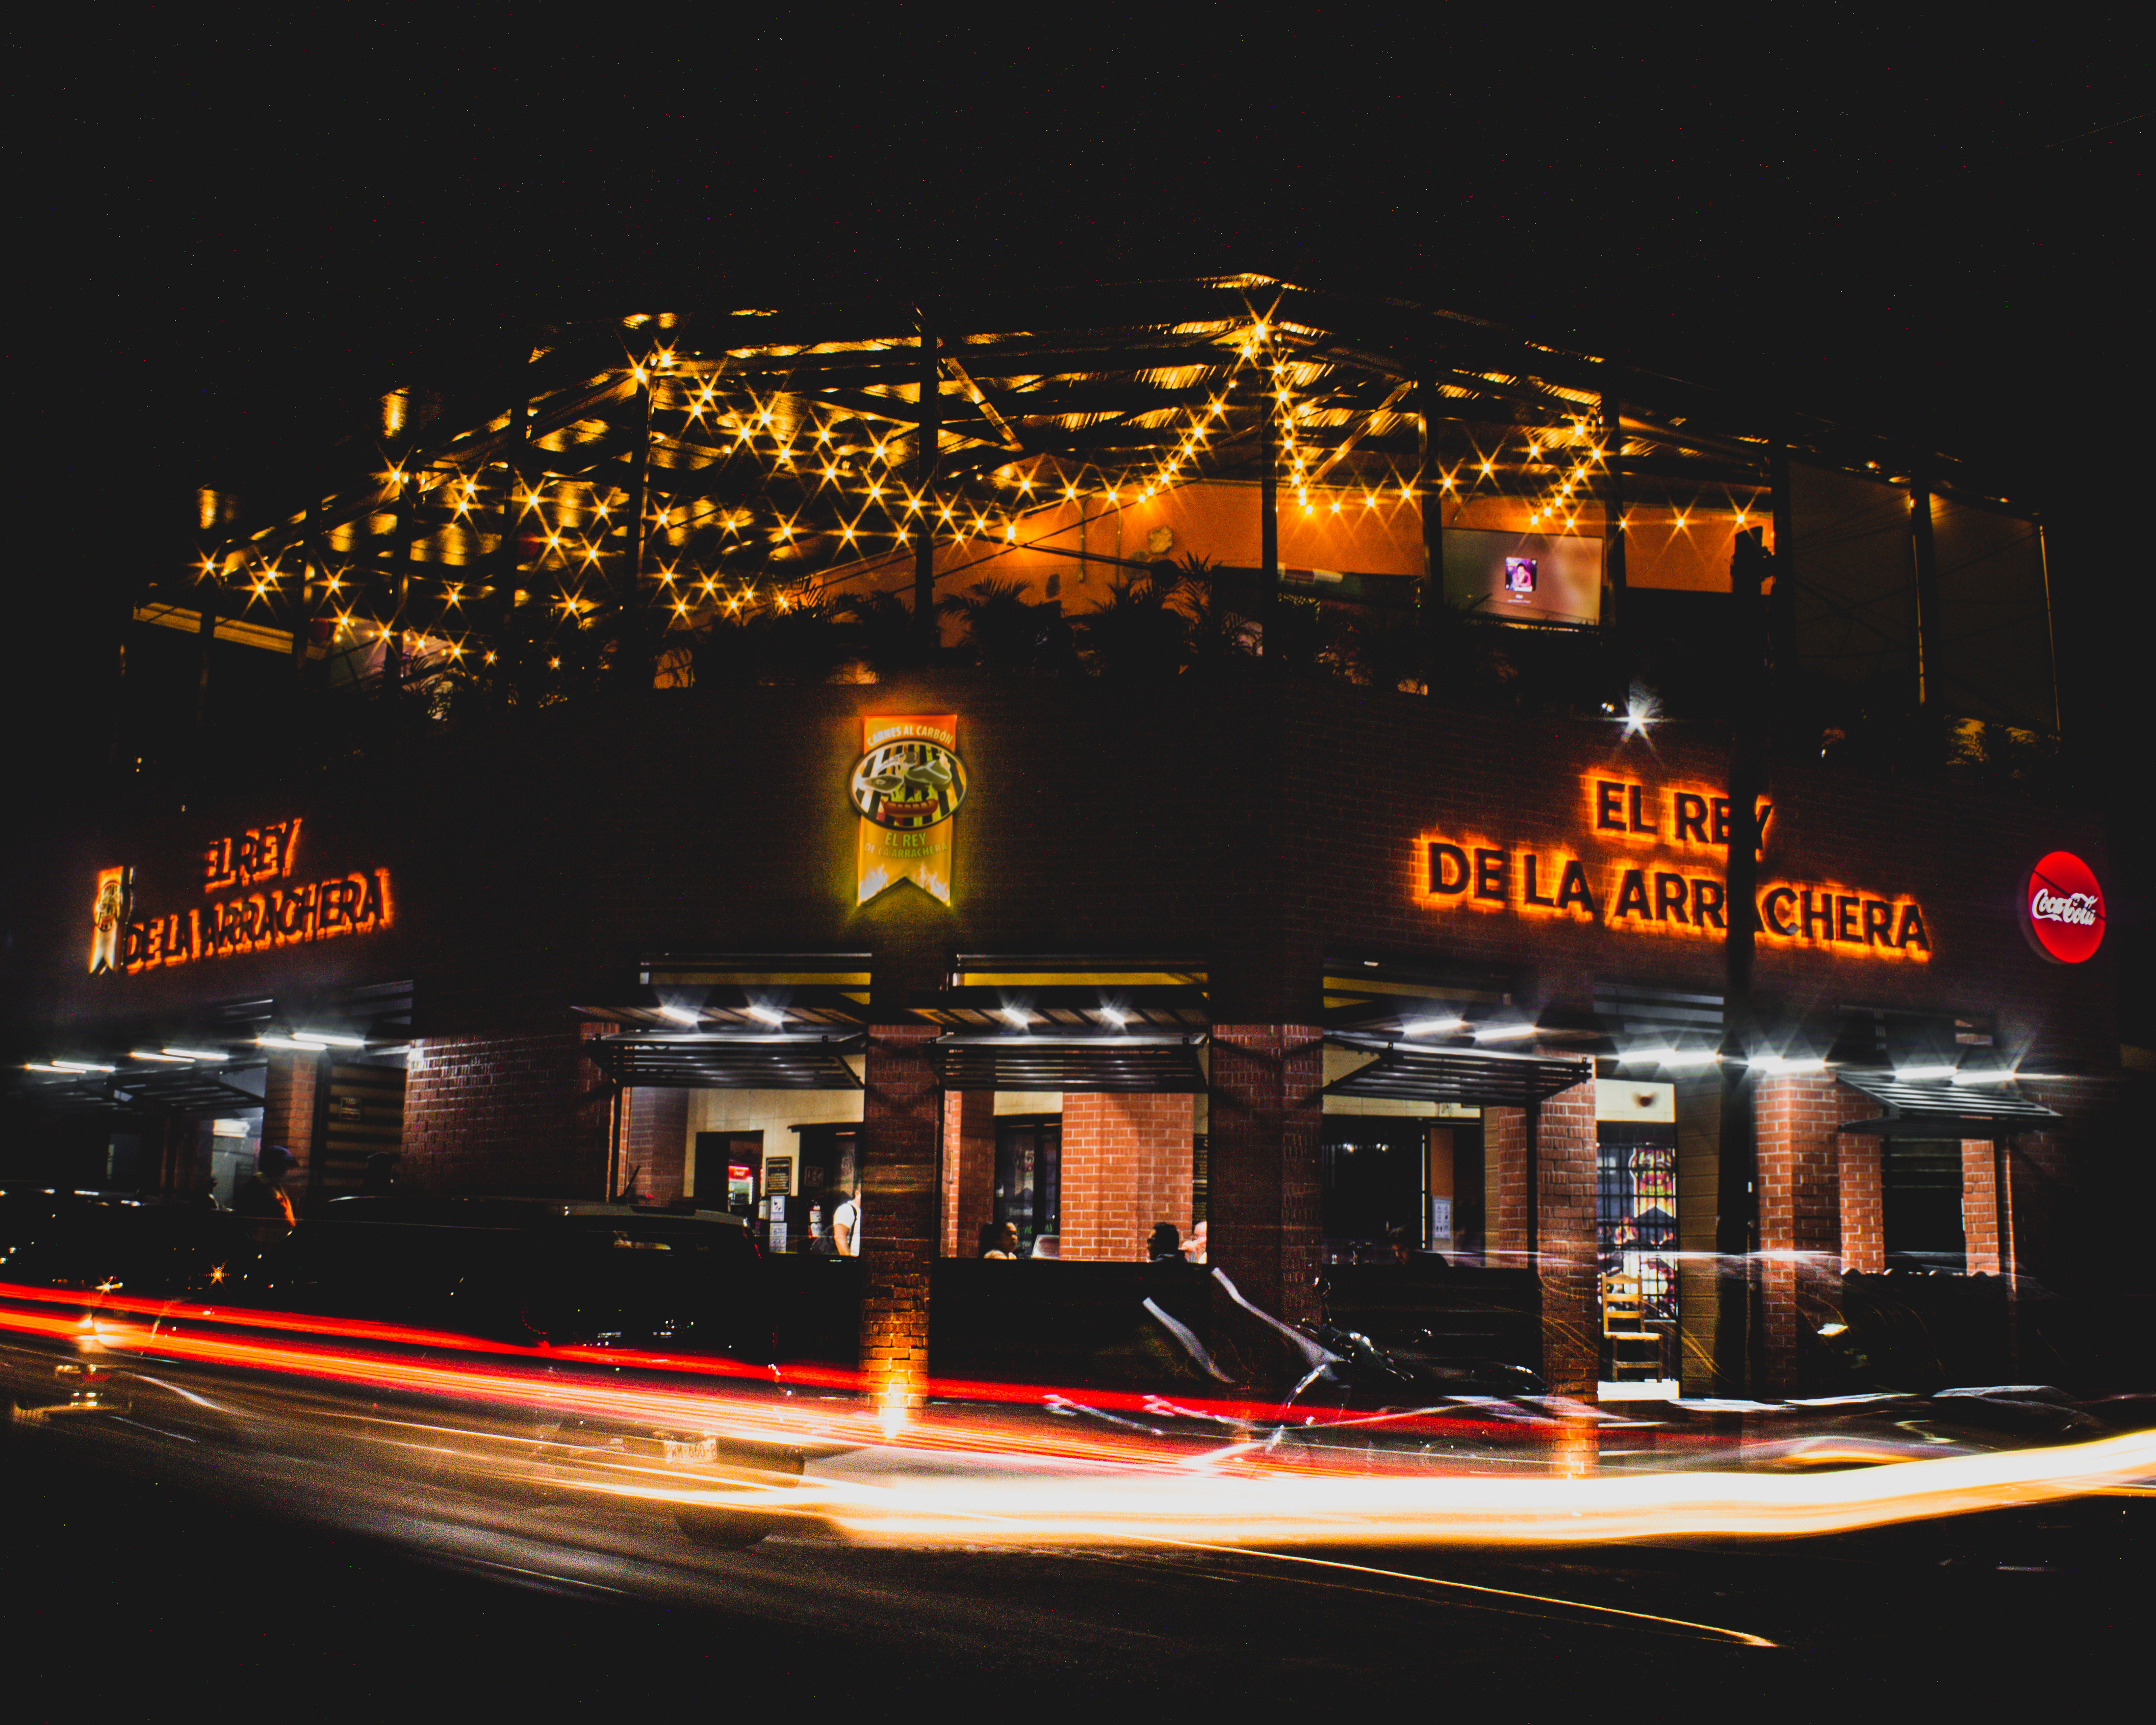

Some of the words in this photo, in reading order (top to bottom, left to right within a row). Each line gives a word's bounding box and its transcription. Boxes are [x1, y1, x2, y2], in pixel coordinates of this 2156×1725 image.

[867, 726, 901, 746] CARNES
[903, 725, 914, 736] AL
[916, 725, 953, 745] CARBÓN
[1597, 780, 1657, 835] EL
[205, 836, 234, 885] EL
[234, 819, 296, 880] REY
[864, 843, 876, 854] DE
[878, 847, 889, 858] LA
[890, 842, 948, 858] ARRACHERA
[884, 832, 899, 847] EL
[903, 832, 927, 847] REY
[124, 918, 162, 971] DE
[203, 869, 388, 956] ARRACHERA
[1428, 842, 1505, 901] DE
[1523, 854, 1594, 912] LA
[1614, 869, 1930, 950] ARRCHERA
